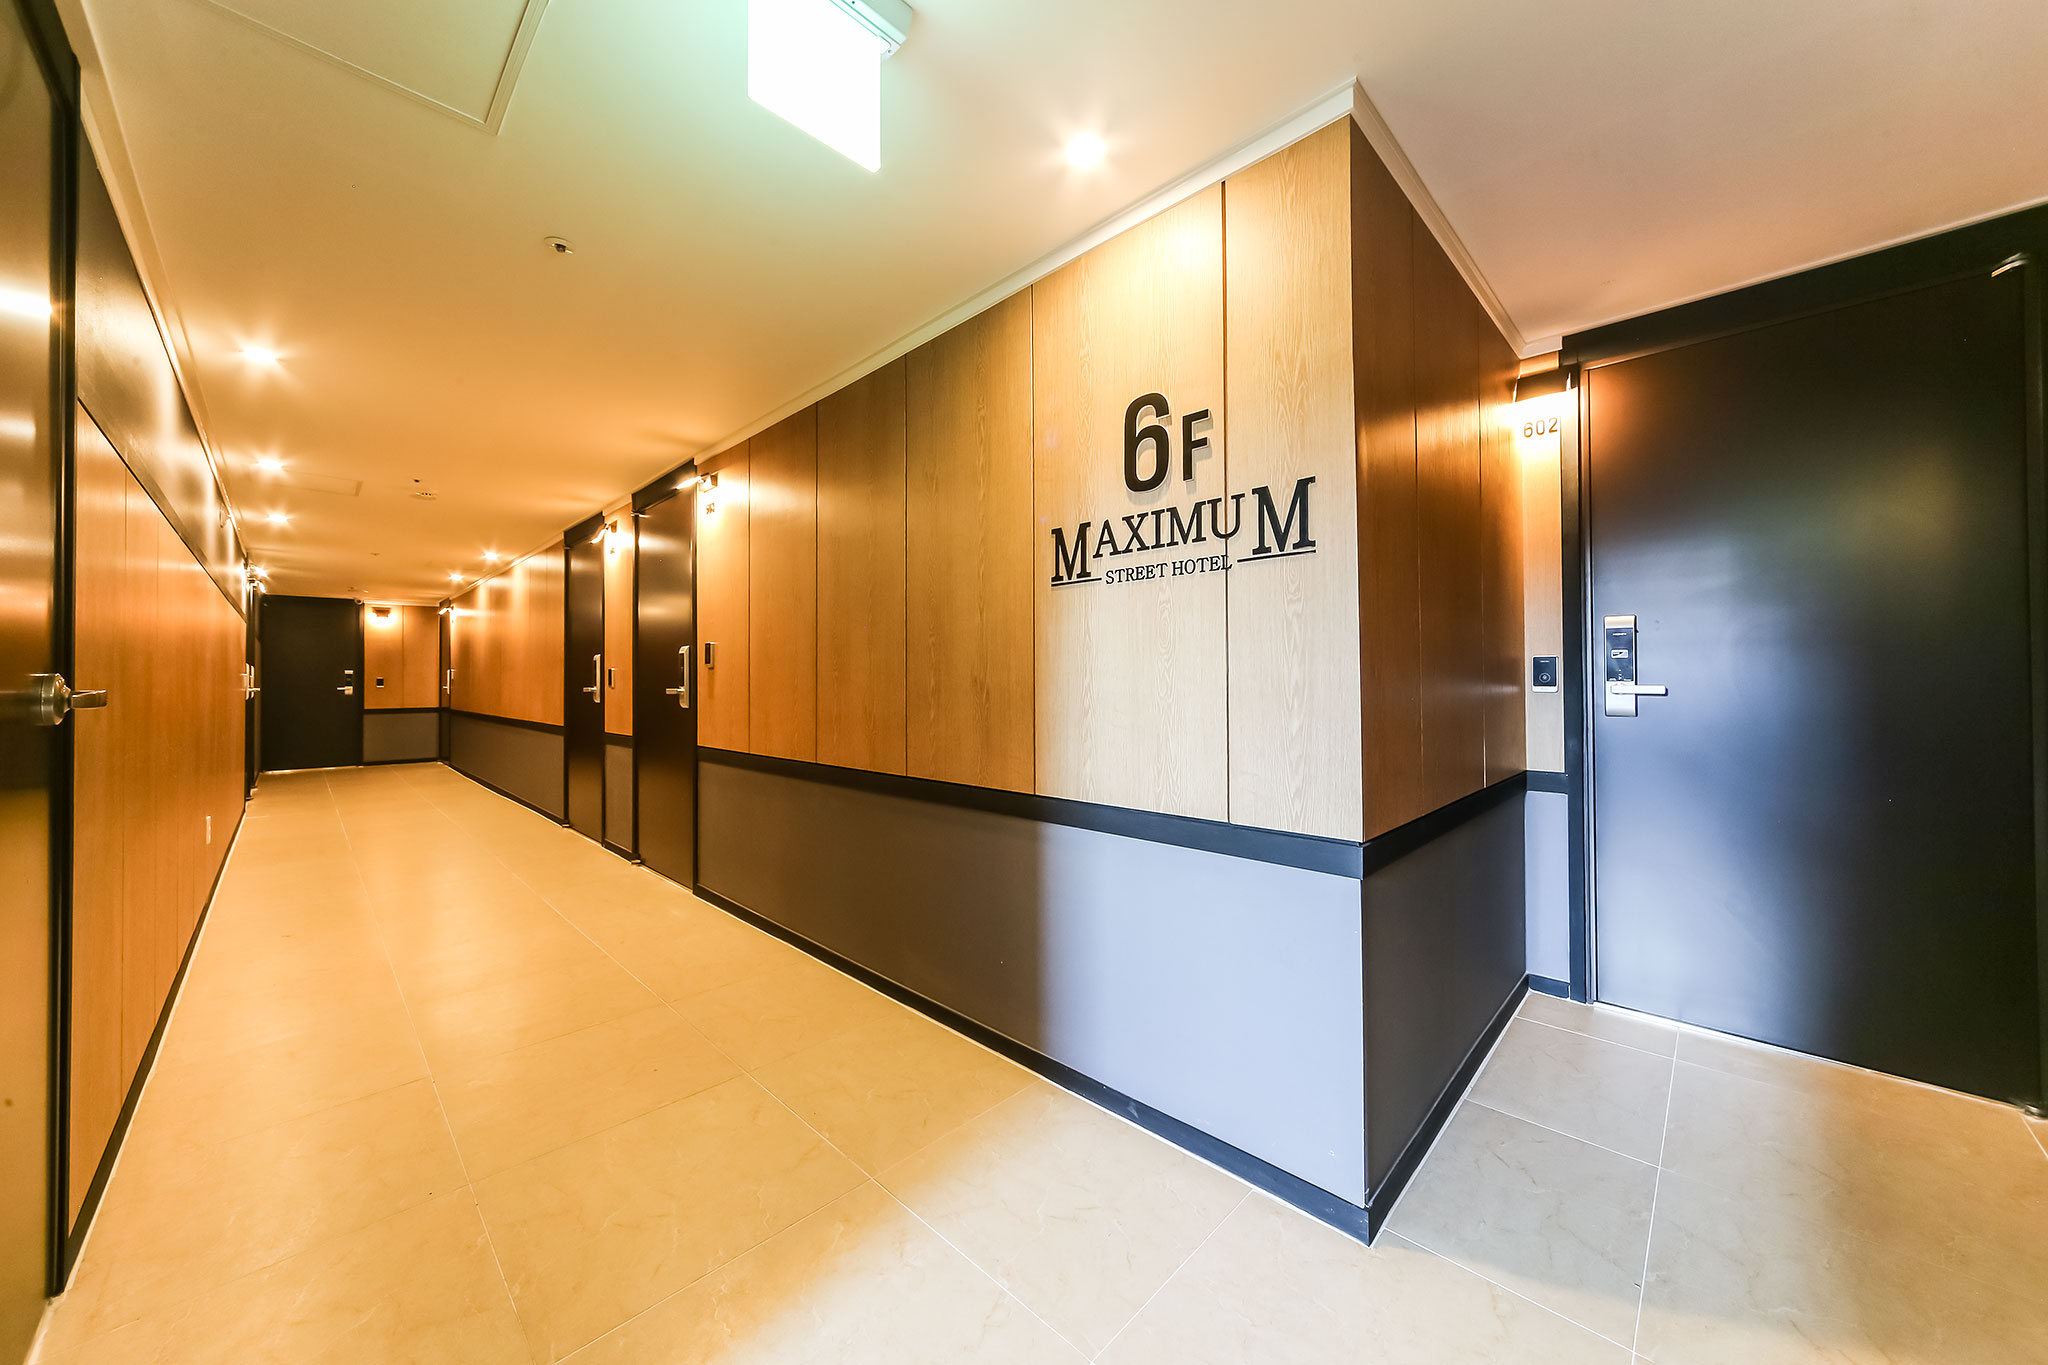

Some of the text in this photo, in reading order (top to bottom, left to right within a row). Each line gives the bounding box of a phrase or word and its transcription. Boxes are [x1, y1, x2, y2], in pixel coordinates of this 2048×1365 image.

[1124, 391, 1210, 493] 6F
[1523, 417, 1559, 439] 602
[1050, 475, 1317, 583] MAXIMUM
[1105, 554, 1233, 585] STREET HOTEL
